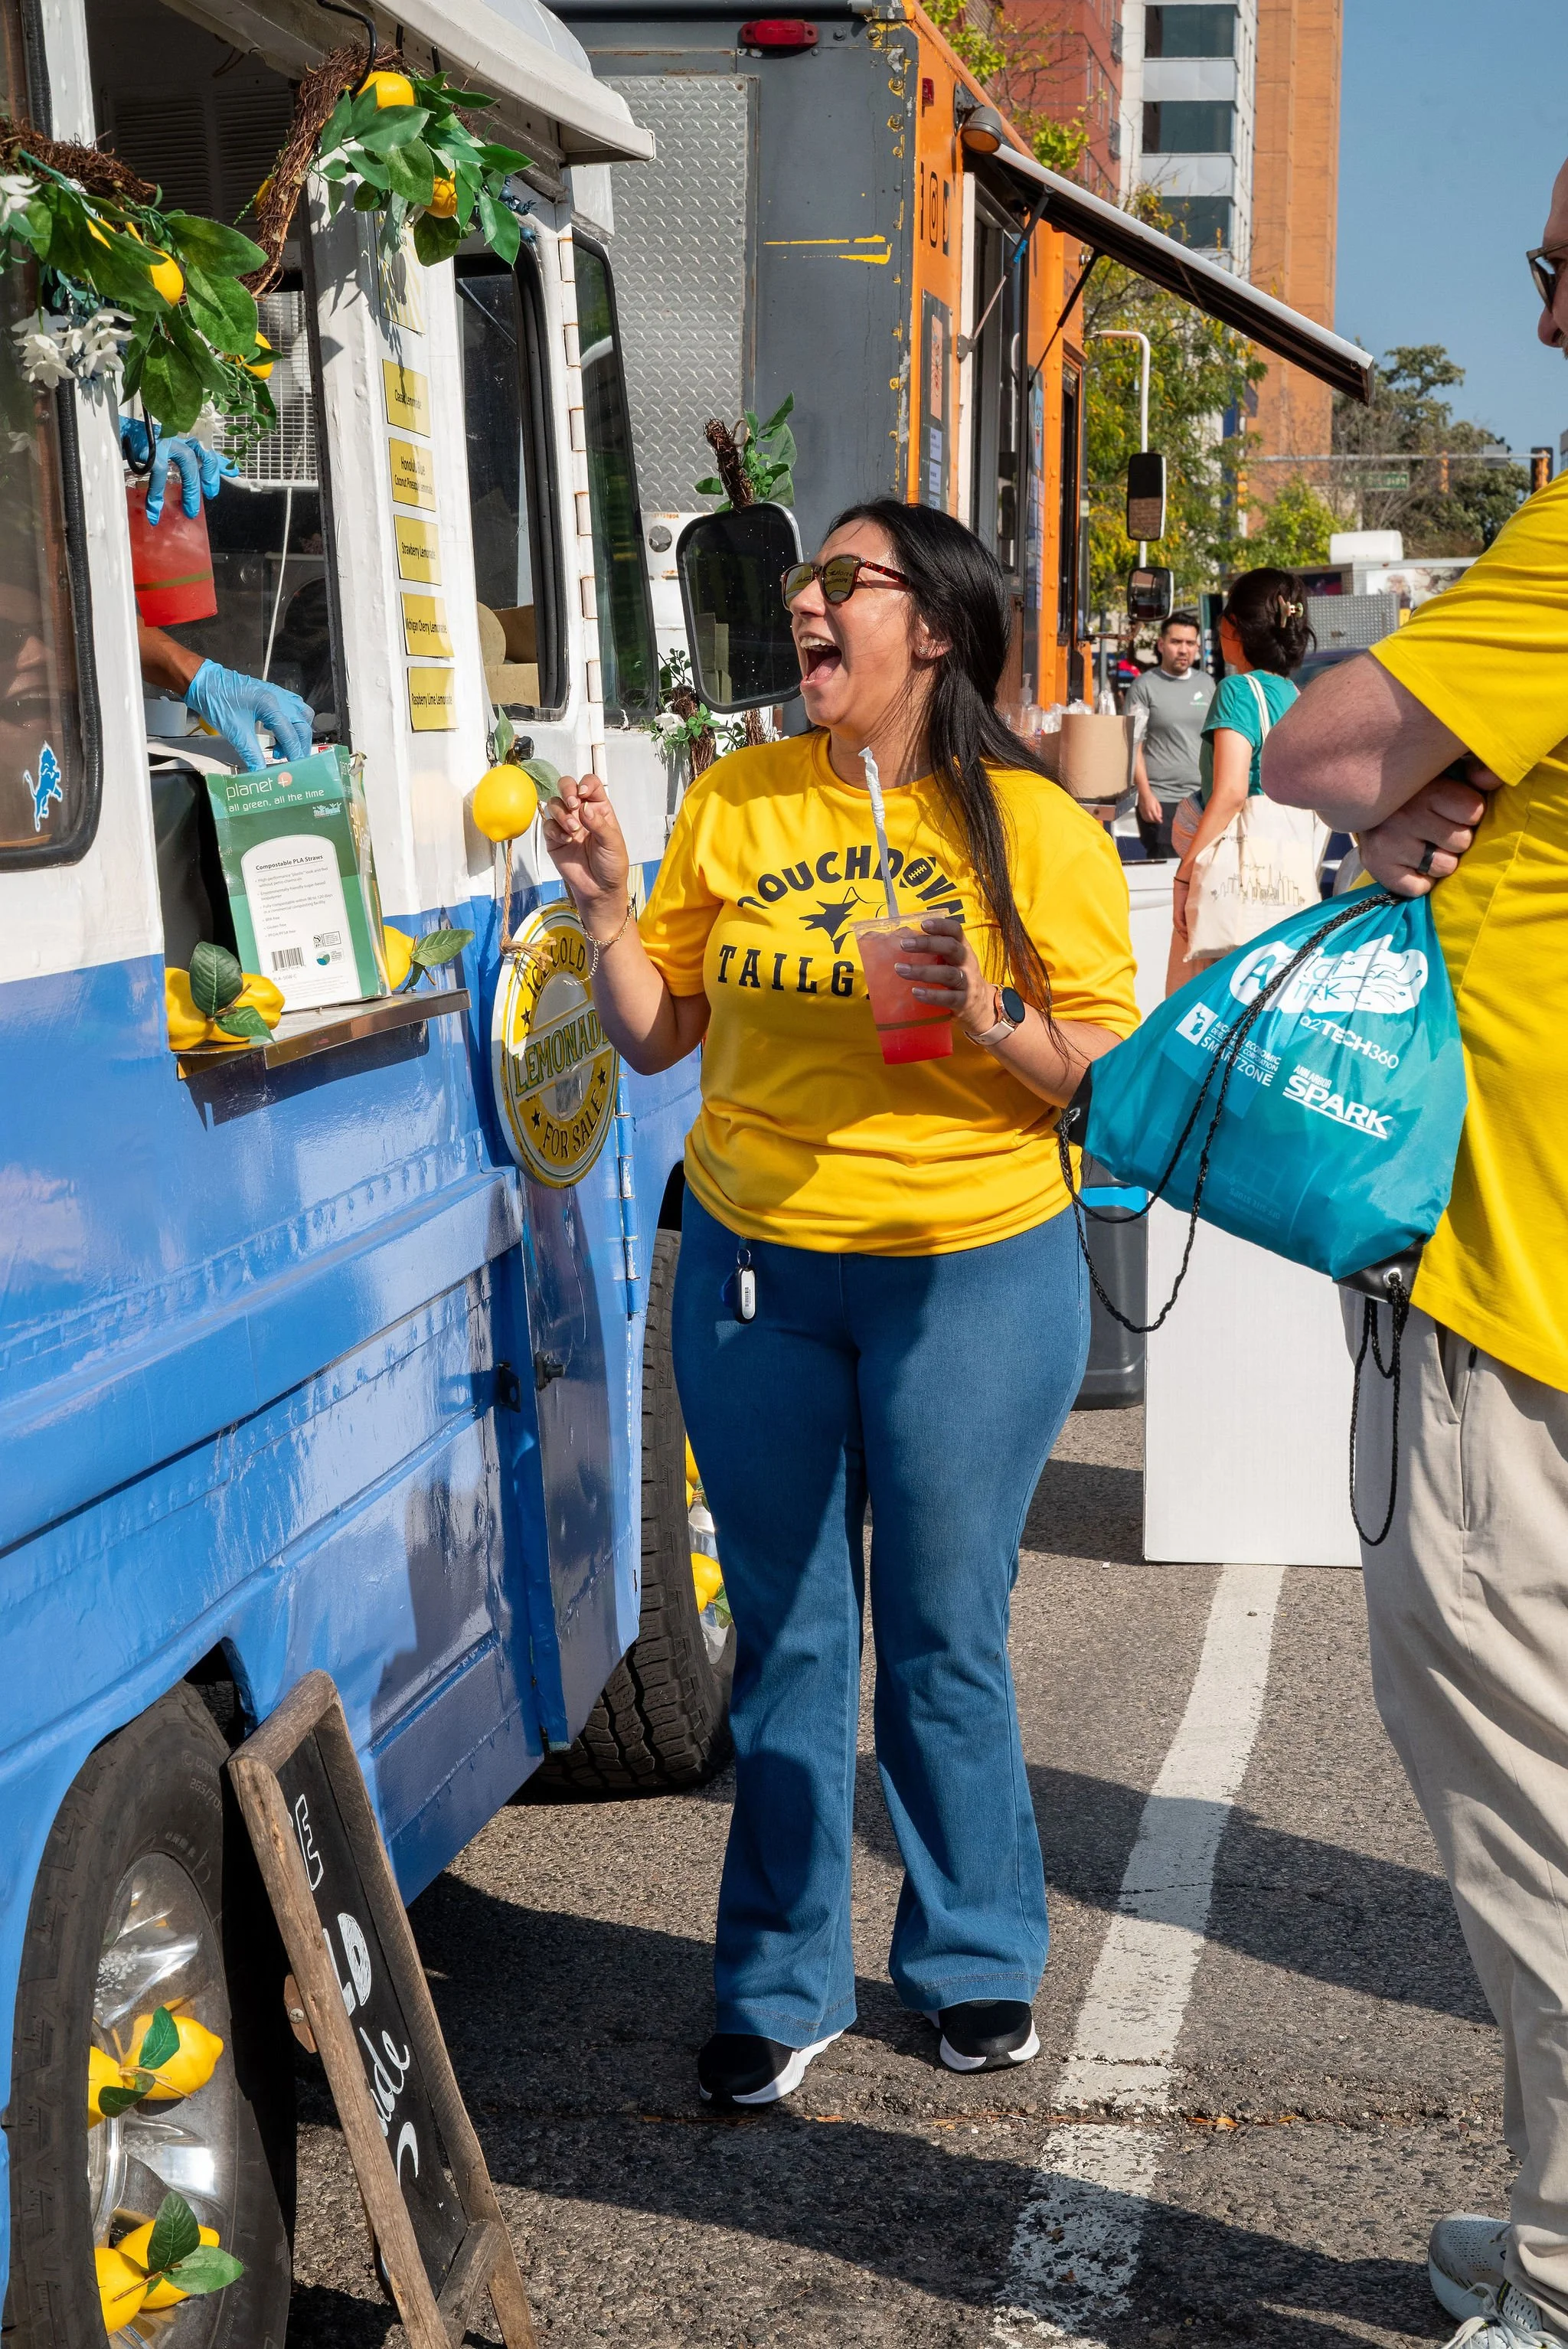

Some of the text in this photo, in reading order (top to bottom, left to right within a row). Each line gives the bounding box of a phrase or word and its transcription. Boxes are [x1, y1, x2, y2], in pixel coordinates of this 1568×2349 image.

[401, 541, 436, 560] Strawberry Lemonade
[418, 619, 430, 635] Cherry
[430, 621, 447, 634] Lemonade
[411, 692, 427, 708] Raspberry
[436, 693, 452, 705] Lemonade
[226, 777, 273, 801] planet
[229, 804, 240, 812] all
[274, 796, 285, 805] all
[287, 792, 302, 802] the
[305, 789, 325, 799] time
[256, 861, 292, 870] Compostable
[550, 936, 586, 972] COLD
[717, 944, 871, 999] TAILG
[1245, 1040, 1282, 1066] ECONOMIC
[1293, 1064, 1332, 1090] ANN ARBOR
[1288, 1074, 1393, 1135] SPARK
[543, 1089, 603, 1158] FOR SALE
